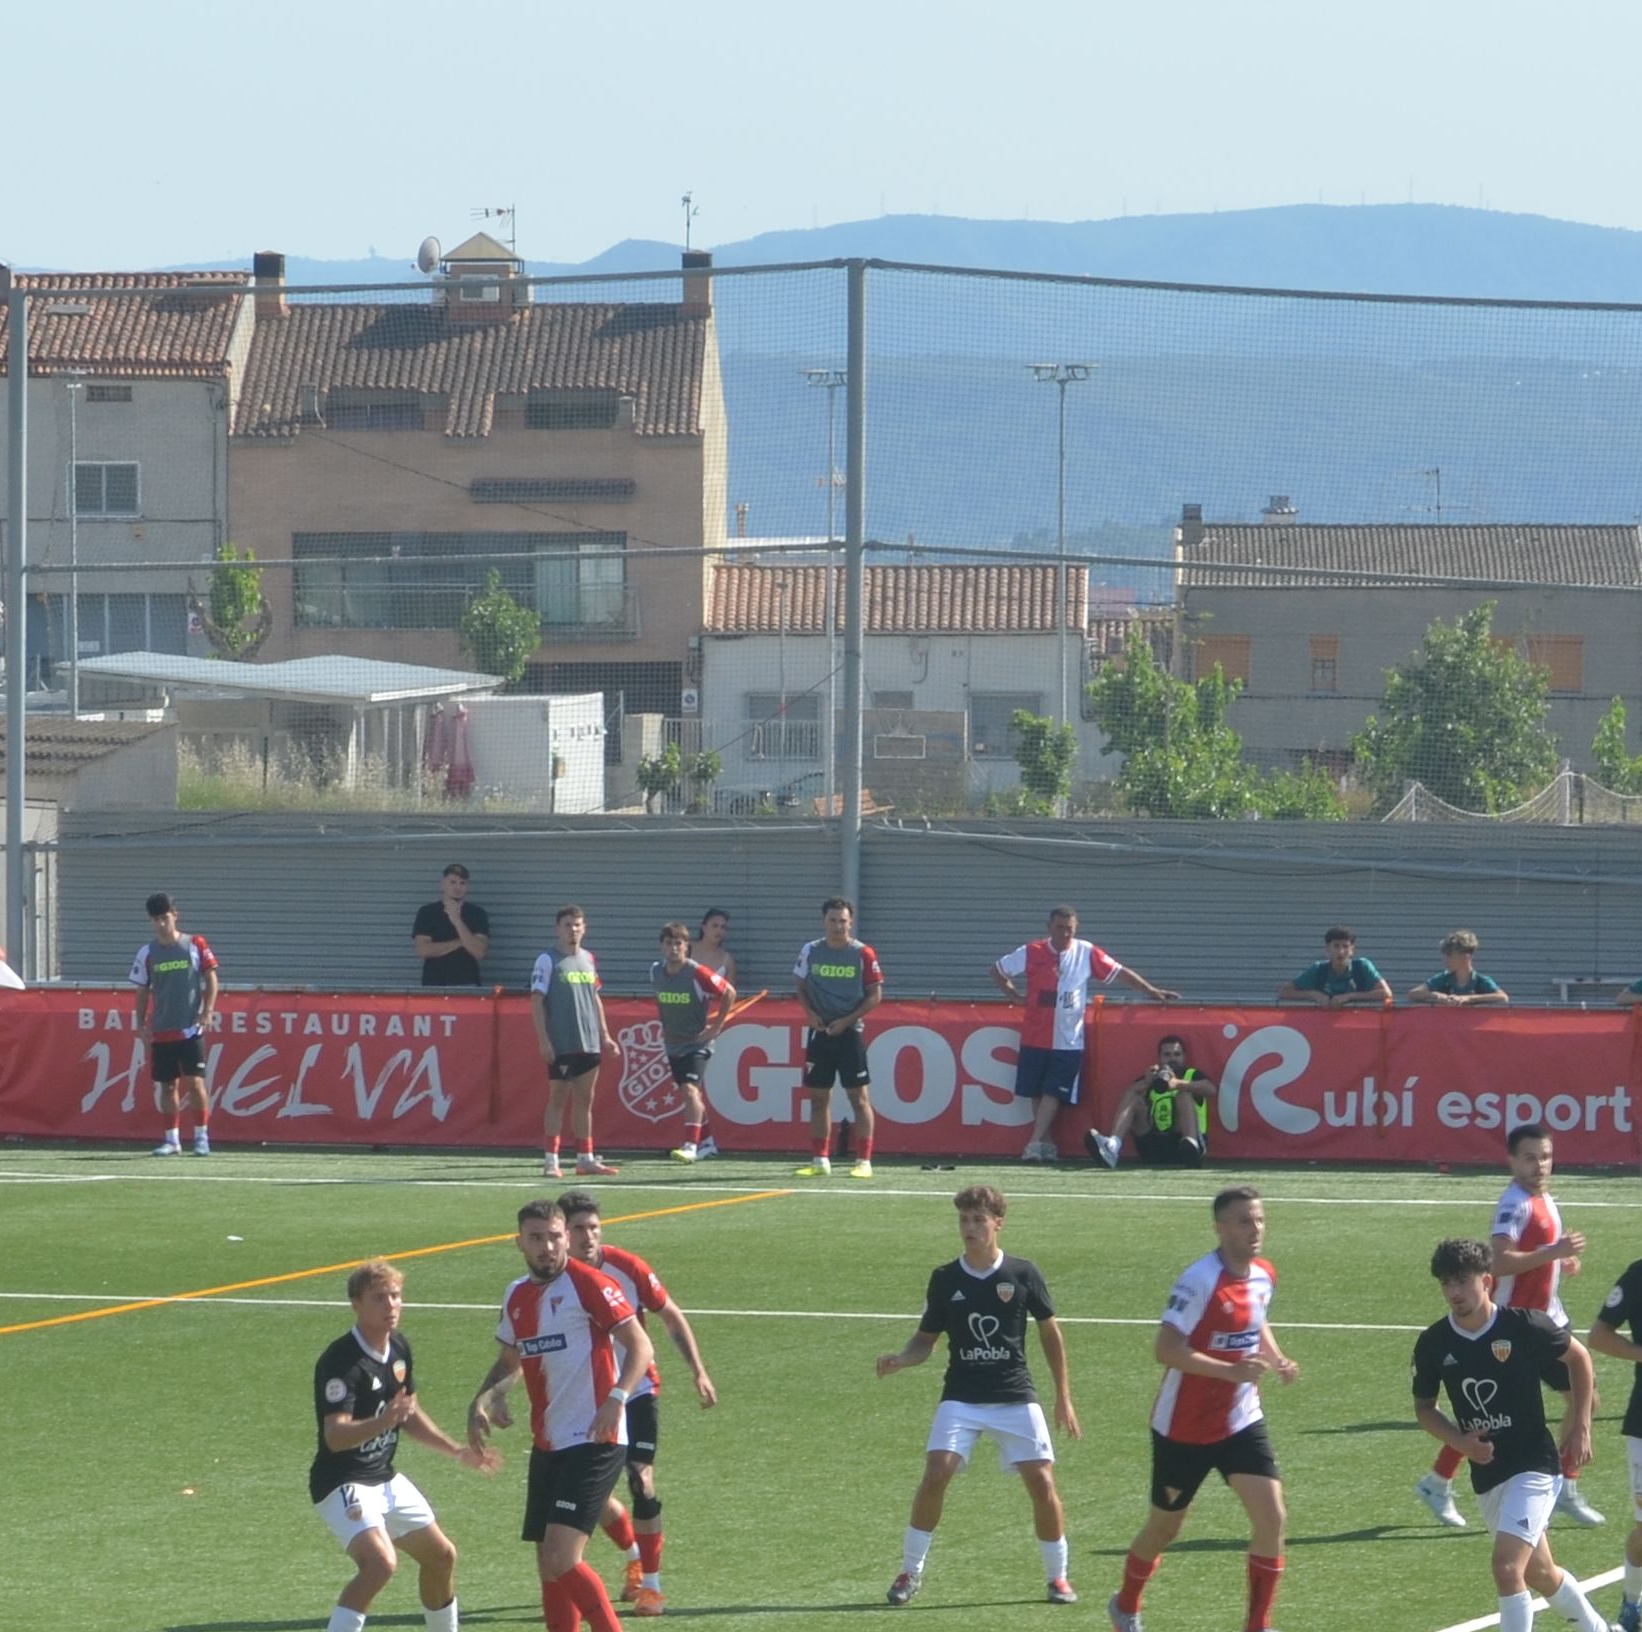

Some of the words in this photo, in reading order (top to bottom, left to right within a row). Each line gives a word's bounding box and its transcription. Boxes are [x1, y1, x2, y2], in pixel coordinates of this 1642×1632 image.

[820, 964, 855, 978] GIOS
[660, 992, 690, 1004] GIOS
[78, 1008, 137, 1031] BA
[209, 1011, 457, 1037] RESTAURANT
[1218, 1024, 1419, 1135] Rubí
[1436, 1086, 1633, 1142] esport
[960, 1346, 1010, 1361] LaPobla
[341, 1485, 359, 1508] 12
